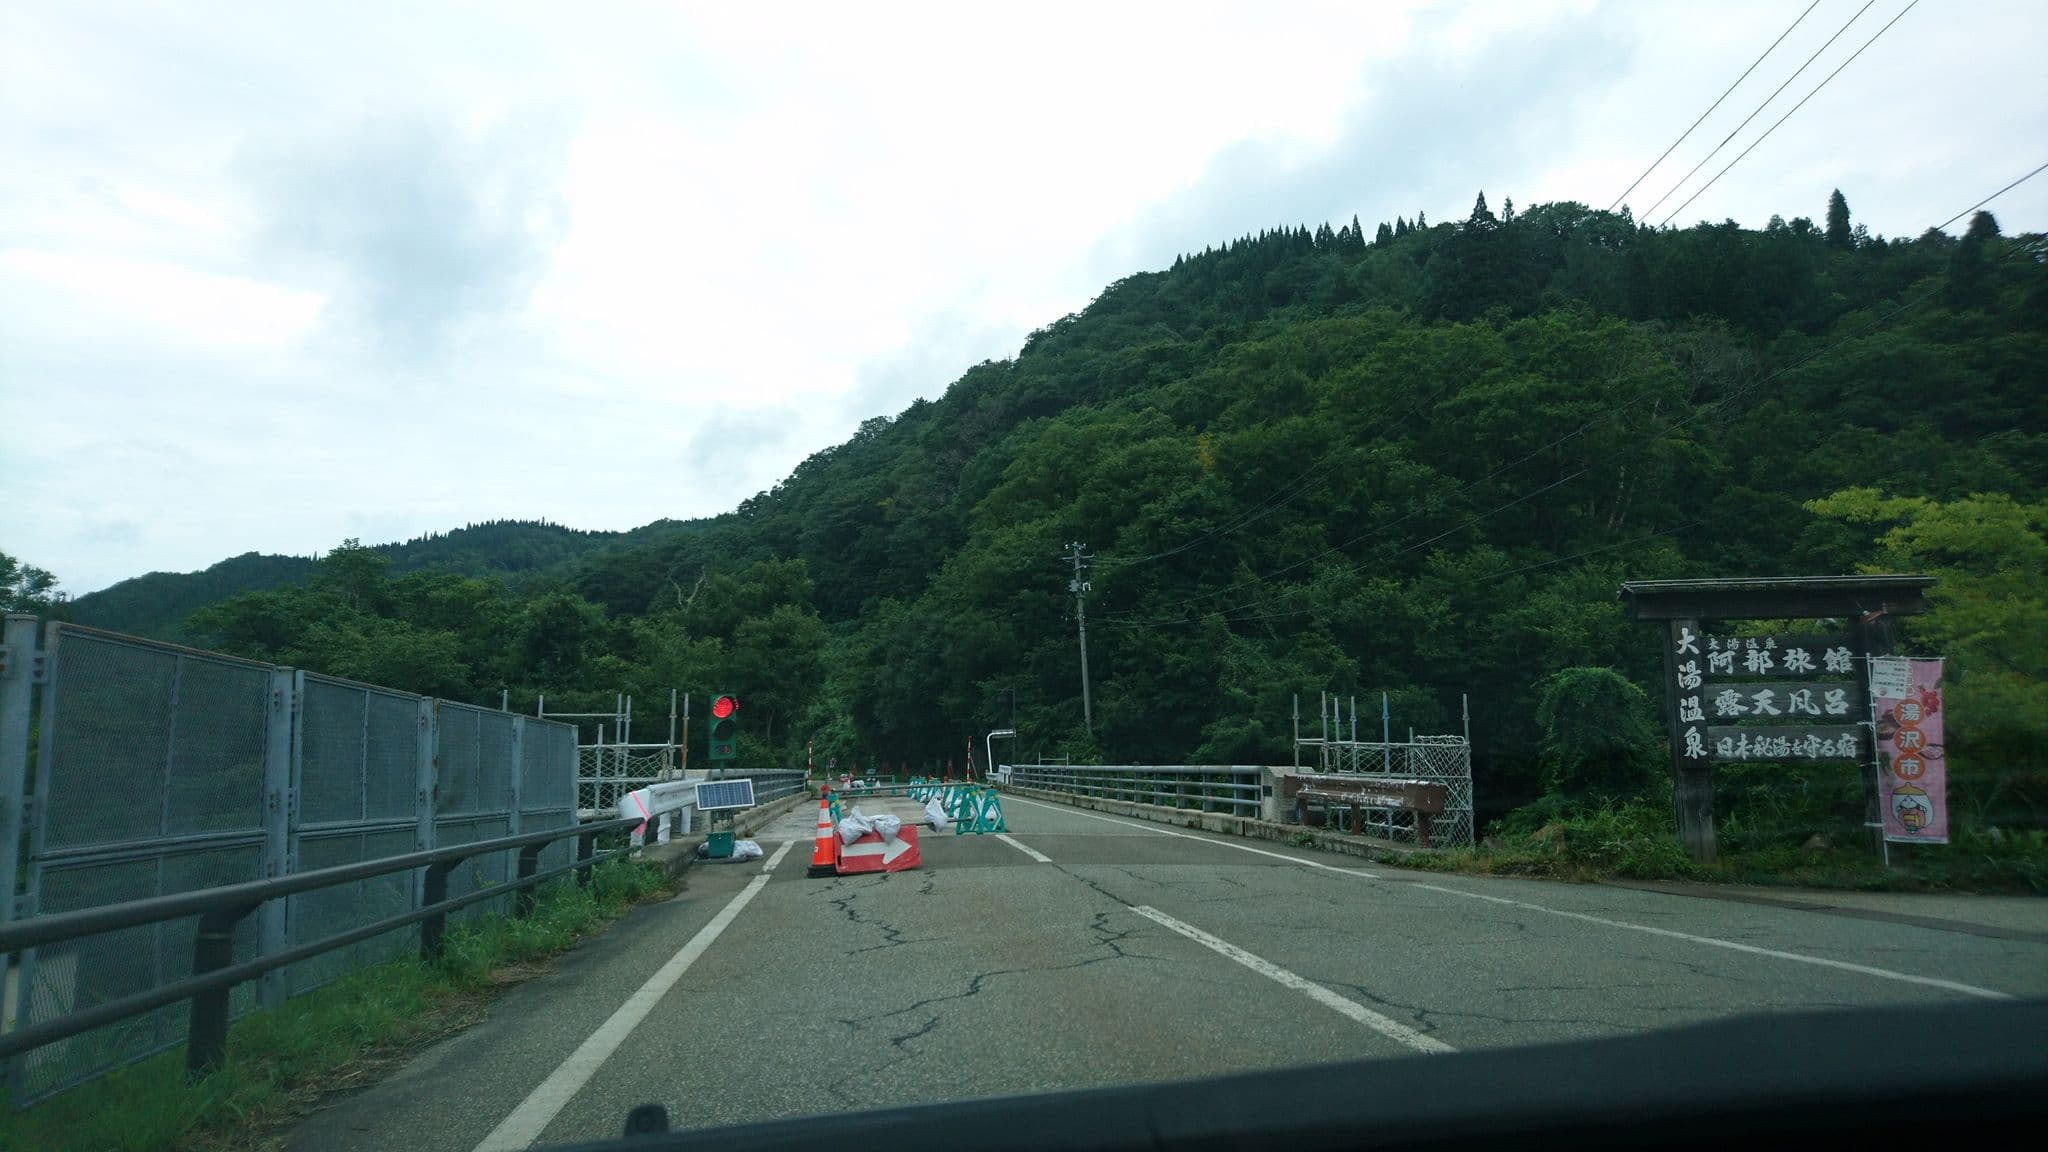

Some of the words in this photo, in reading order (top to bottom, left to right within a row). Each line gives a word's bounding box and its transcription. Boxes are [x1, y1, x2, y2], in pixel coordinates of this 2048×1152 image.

[1708, 637, 1778, 650] 大湯温泉
[1707, 646, 1853, 675] 阿部旅館
[1676, 627, 1707, 760] 大湯温泉
[1714, 689, 1850, 716] 露天風呂
[1716, 733, 1858, 759] 日本秘湯を守る宿
[1900, 703, 1922, 775] 湯沢市
